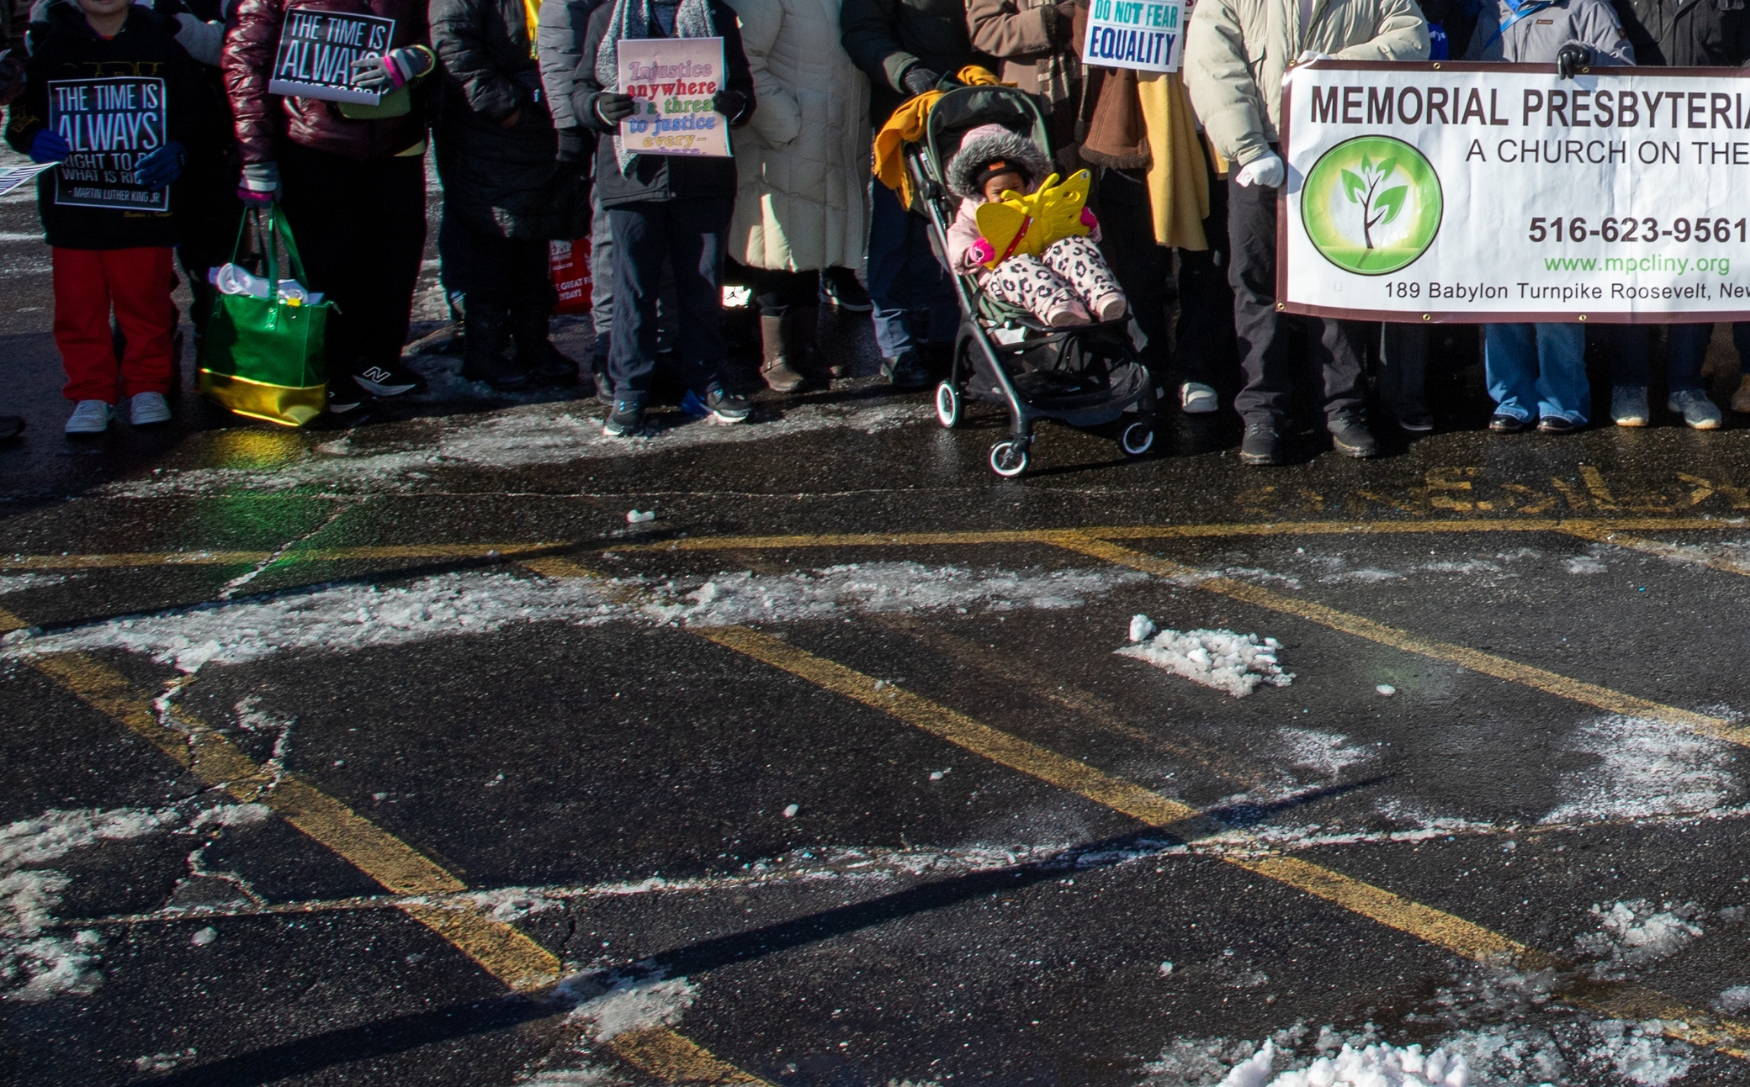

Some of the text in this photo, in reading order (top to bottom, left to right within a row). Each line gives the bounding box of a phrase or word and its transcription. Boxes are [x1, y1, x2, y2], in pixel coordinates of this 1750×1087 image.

[1114, 0, 1144, 25] NOT
[1146, 4, 1178, 29] FEAR
[292, 13, 386, 50] THE TIME IS
[1089, 26, 1176, 65] EQUALITY
[629, 60, 713, 83] Injustice
[55, 83, 158, 111] THE TIME IS
[627, 79, 716, 101] anywhere
[647, 102, 658, 114] a
[664, 96, 714, 114] threa
[1311, 86, 1509, 126] MEMORIAL
[59, 112, 158, 152] ALWAYS
[630, 113, 716, 136] to justice
[111, 153, 132, 171] TO
[1465, 139, 1487, 162] A
[1497, 139, 1626, 164] CHURCH
[1638, 141, 1680, 164] ON
[1691, 142, 1749, 164] THE
[61, 168, 99, 181] WHAT
[104, 171, 117, 183] IS
[74, 187, 101, 198] MARTIN
[103, 189, 129, 201] LUTHER
[131, 191, 149, 202] KING
[1529, 216, 1747, 243] 516-623-9561
[1544, 254, 1730, 276] www.mpcliny.org
[1385, 282, 1420, 298] 189
[1428, 282, 1508, 302] Babylon
[1516, 283, 1602, 303] Turnpike
[1611, 283, 1711, 300] Roosevelt,
